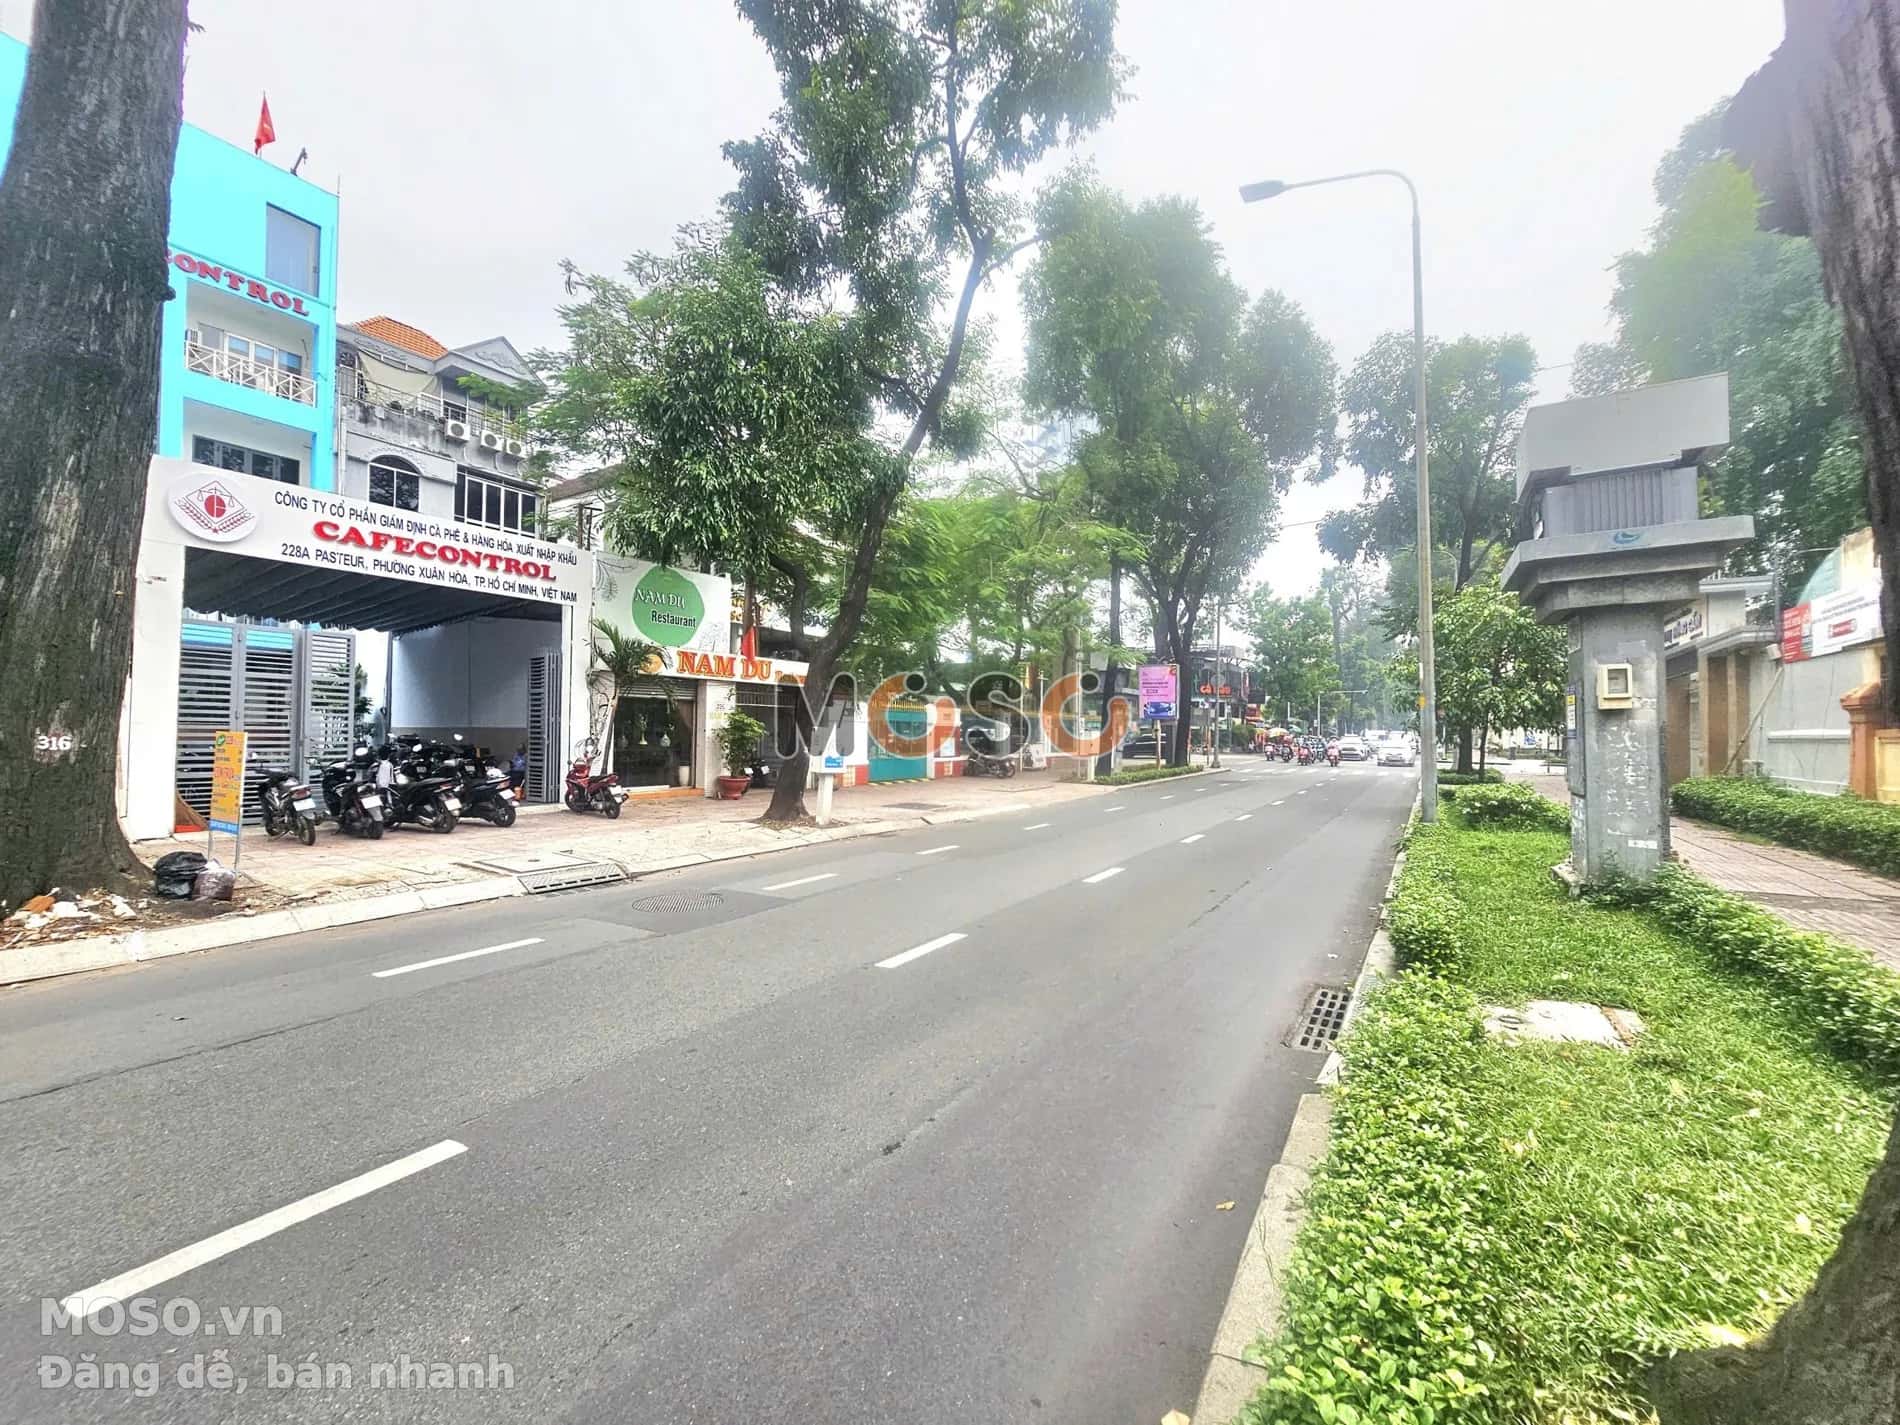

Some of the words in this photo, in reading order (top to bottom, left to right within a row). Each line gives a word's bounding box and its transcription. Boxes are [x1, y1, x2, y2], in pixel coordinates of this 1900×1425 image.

[275, 491, 308, 510] CÔNG
[312, 500, 327, 514] TY
[329, 500, 345, 518] CỔ
[379, 514, 404, 531] GIÁM
[406, 520, 427, 535] ĐỊNH
[429, 523, 442, 538] CÀ
[444, 528, 461, 542] PHÊ
[463, 531, 469, 543] &
[471, 532, 495, 549] HÀNG
[516, 542, 535, 557] XUẤT
[537, 547, 556, 562] NHẬP
[558, 550, 577, 566] KHẨU
[313, 521, 557, 582] CAFECONTROL
[281, 543, 310, 560] 228A
[315, 549, 368, 570] PASTEUR,
[373, 558, 415, 576] PHƯỜNG
[418, 566, 445, 582] XUÂN
[503, 580, 516, 593] CHÍ
[518, 583, 538, 597] MINH,
[541, 586, 558, 602] VIỆT
[560, 591, 577, 602] NAM
[635, 588, 667, 606] NAM
[669, 593, 686, 609] DU
[651, 610, 697, 628] Restaurant
[676, 650, 736, 678] NAM
[740, 657, 773, 681] DU
[37, 735, 73, 751] 316
